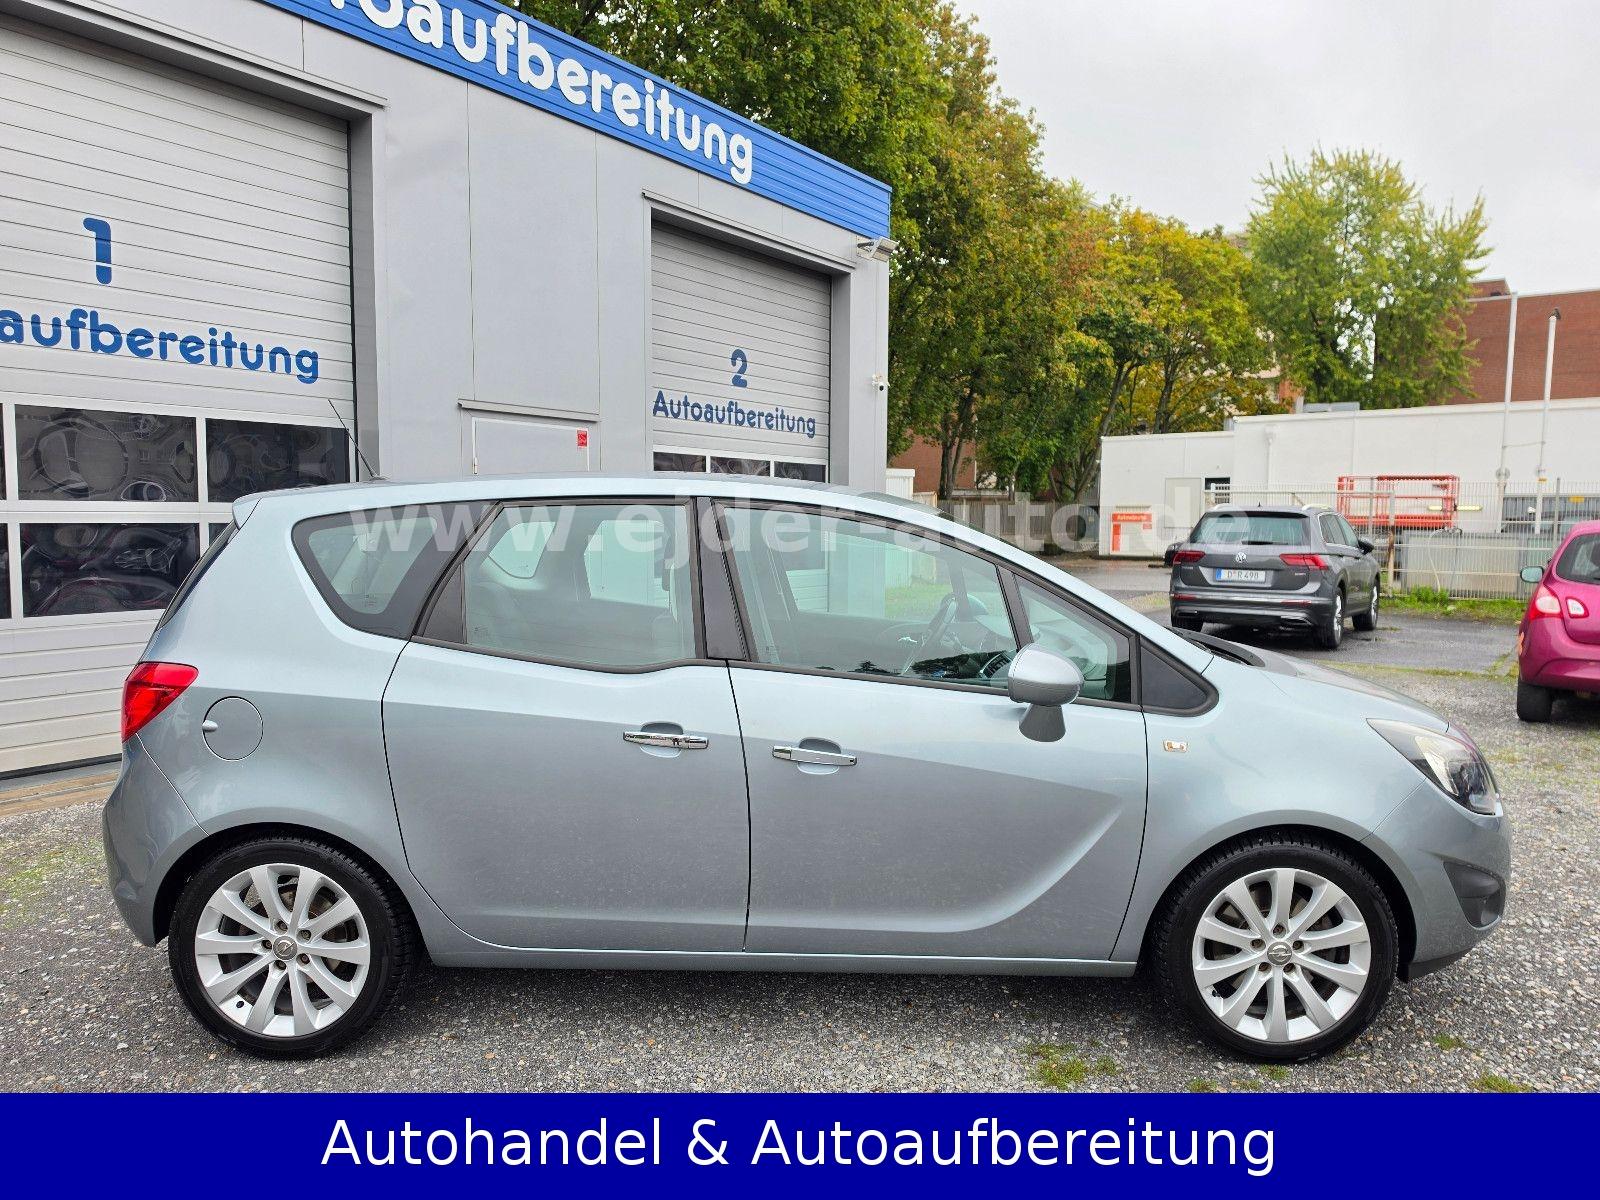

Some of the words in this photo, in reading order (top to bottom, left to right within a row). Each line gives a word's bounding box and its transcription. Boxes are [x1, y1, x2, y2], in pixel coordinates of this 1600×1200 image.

[330, 0, 753, 185] aufbereitung
[83, 217, 112, 285] 1
[731, 349, 748, 388] 2
[652, 390, 816, 439] Autoaufbereitung
